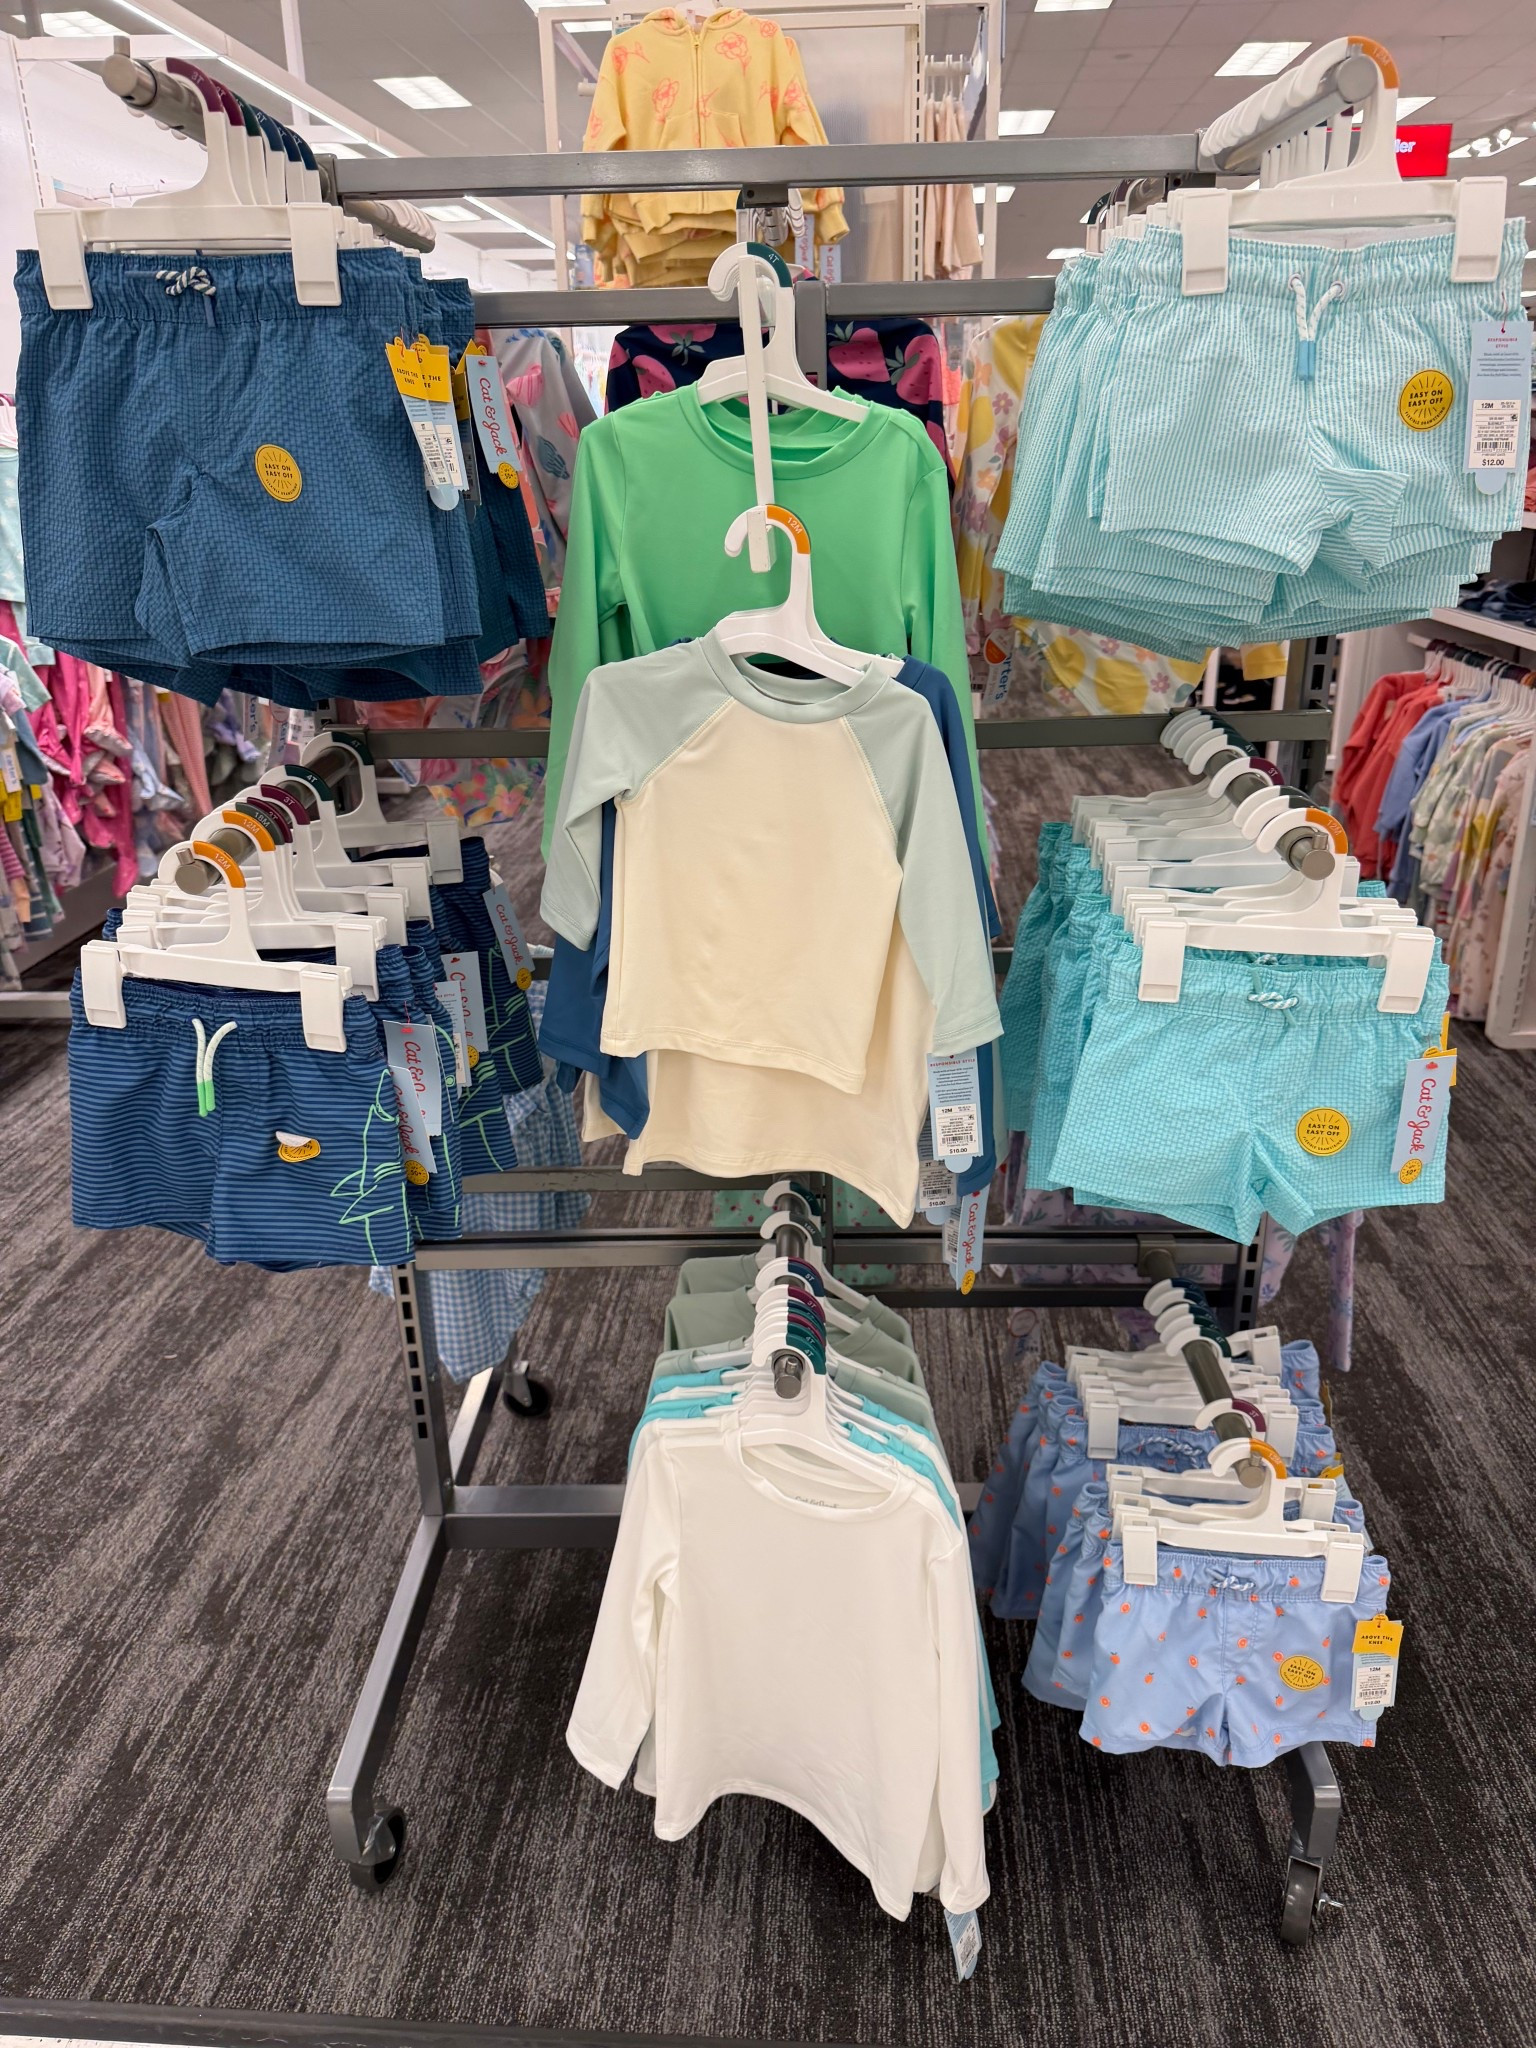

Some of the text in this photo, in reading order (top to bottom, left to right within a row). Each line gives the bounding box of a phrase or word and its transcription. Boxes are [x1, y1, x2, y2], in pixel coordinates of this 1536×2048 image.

[256, 111, 268, 123] 5T
[768, 253, 781, 263] 4T
[480, 377, 493, 403] Cat
[1410, 391, 1428, 399] EASY
[1408, 399, 1427, 407] EASY
[481, 420, 508, 457] Jack
[1481, 458, 1505, 467] $12.00
[787, 517, 803, 534] 12M
[306, 774, 317, 784] 4T
[283, 796, 296, 806] 3T
[243, 818, 261, 834] 12M
[254, 811, 271, 828] 18M
[1327, 819, 1343, 836] 12M
[214, 853, 231, 870] 12M
[495, 904, 508, 925] Cat
[504, 936, 524, 966] Jack
[404, 1041, 422, 1066] Cat
[1418, 1078, 1437, 1104] Cat
[1416, 1104, 1432, 1119] &
[398, 1121, 420, 1156] Jack
[1407, 1120, 1431, 1155] Jack
[968, 1202, 978, 1225] Cat
[962, 1236, 976, 1265] Jack
[804, 1273, 815, 1282] 5T
[807, 1300, 817, 1309] 3T
[805, 1336, 816, 1345] 4T
[804, 1349, 815, 1358] 4T
